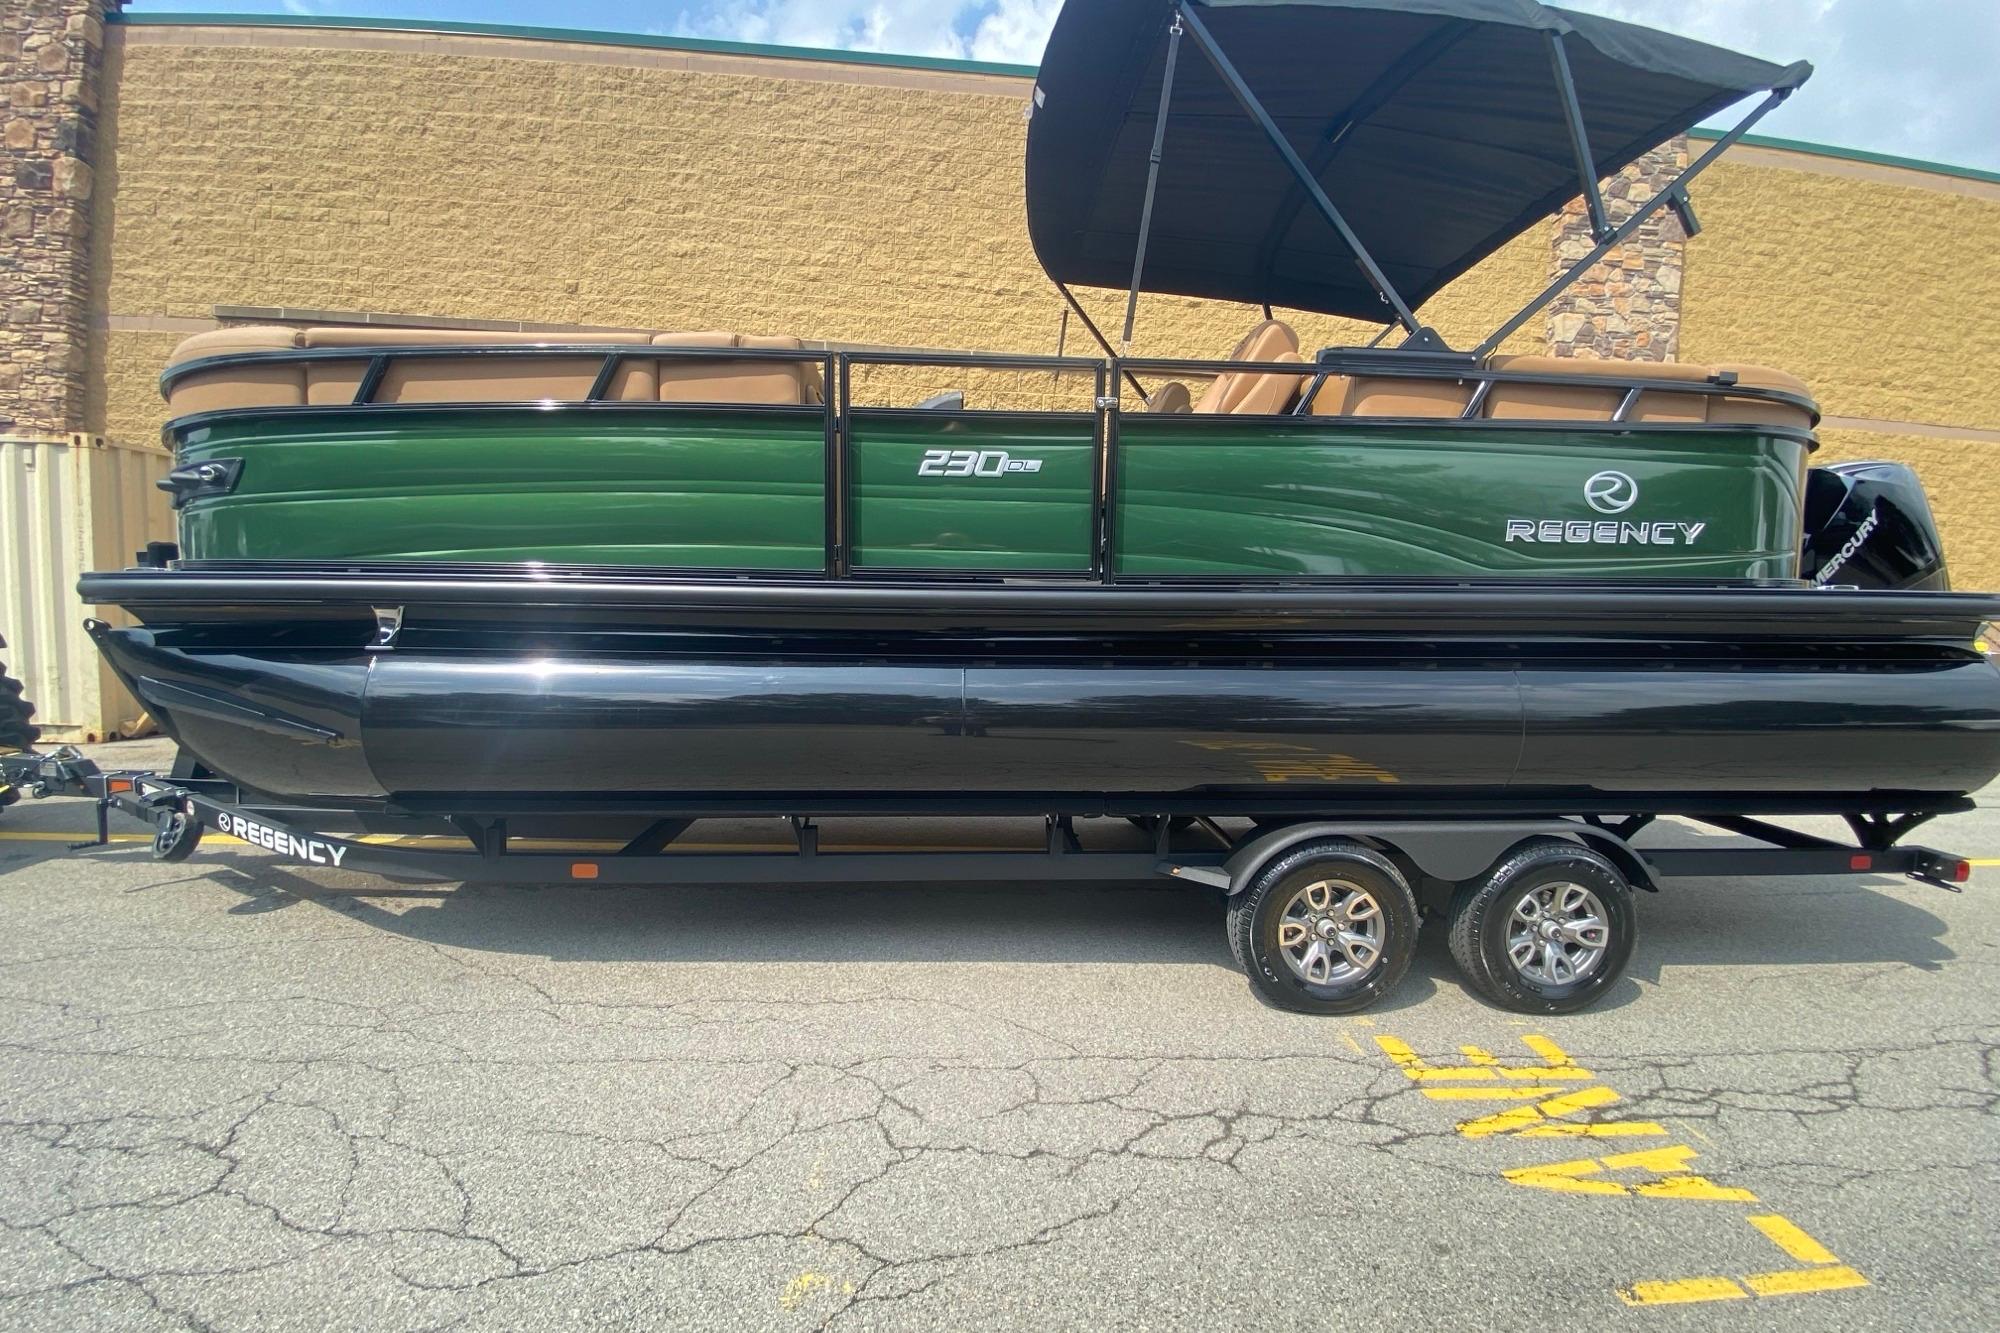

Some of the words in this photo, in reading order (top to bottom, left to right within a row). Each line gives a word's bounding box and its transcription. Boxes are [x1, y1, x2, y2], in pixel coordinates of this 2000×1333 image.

[918, 449, 1009, 478] 230
[1505, 519, 1706, 545] REGENCY
[1811, 508, 1878, 588] MERCURY
[232, 816, 347, 867] REGENCY
